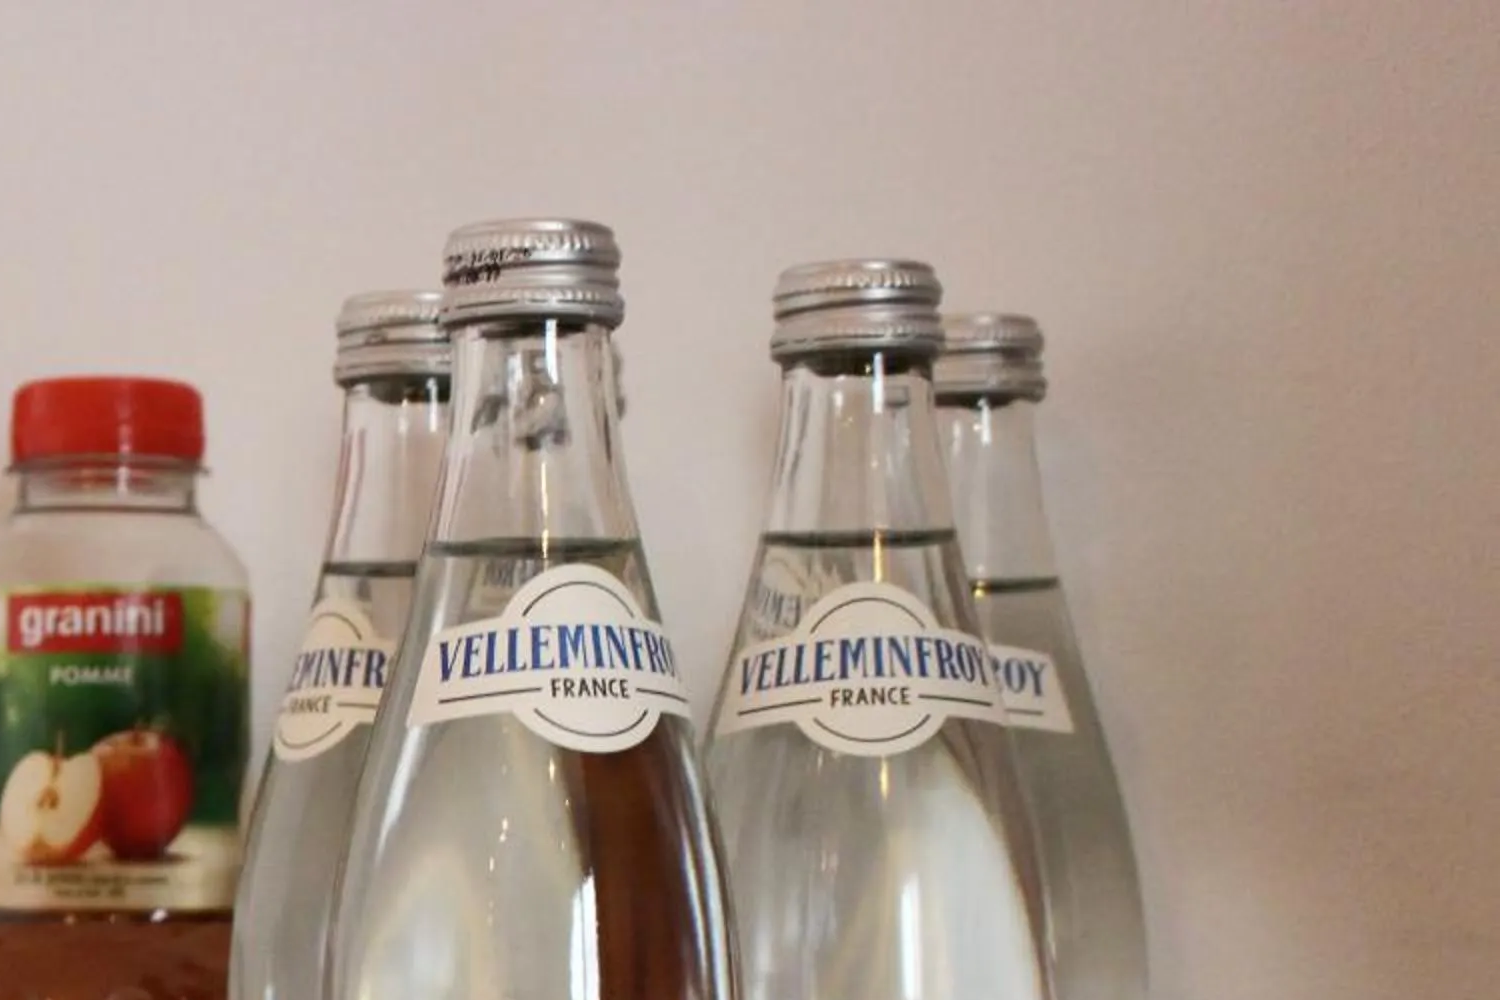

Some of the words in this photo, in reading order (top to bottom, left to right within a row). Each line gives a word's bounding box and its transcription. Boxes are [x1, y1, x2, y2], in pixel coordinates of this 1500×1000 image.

[19, 598, 165, 648] granini
[49, 666, 136, 687] POMME
[740, 635, 989, 696] VELLEMINFROY
[551, 677, 630, 699] FRANCE
[830, 686, 912, 708] FRANCE
